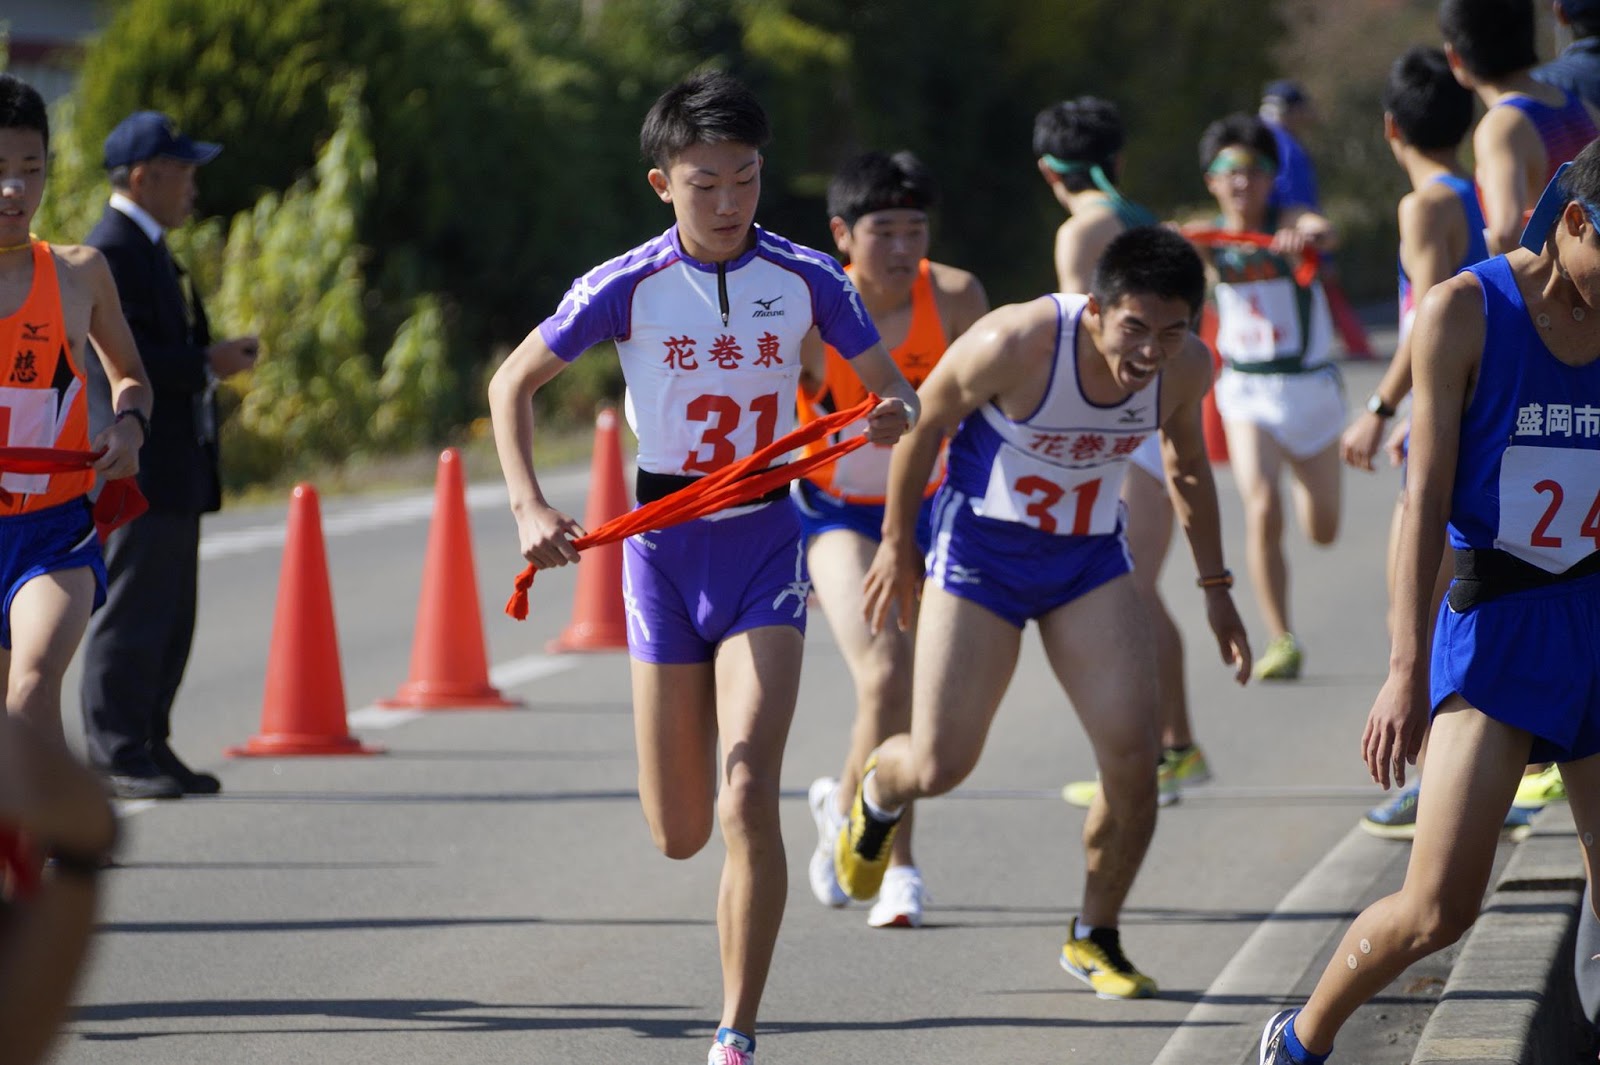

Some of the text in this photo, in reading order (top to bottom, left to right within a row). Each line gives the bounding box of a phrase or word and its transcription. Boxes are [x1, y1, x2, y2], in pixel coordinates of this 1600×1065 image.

[663, 332, 783, 371] 花巻東
[682, 392, 779, 475] 31
[1515, 402, 1600, 438] 盛岡市
[1014, 475, 1103, 535] 31
